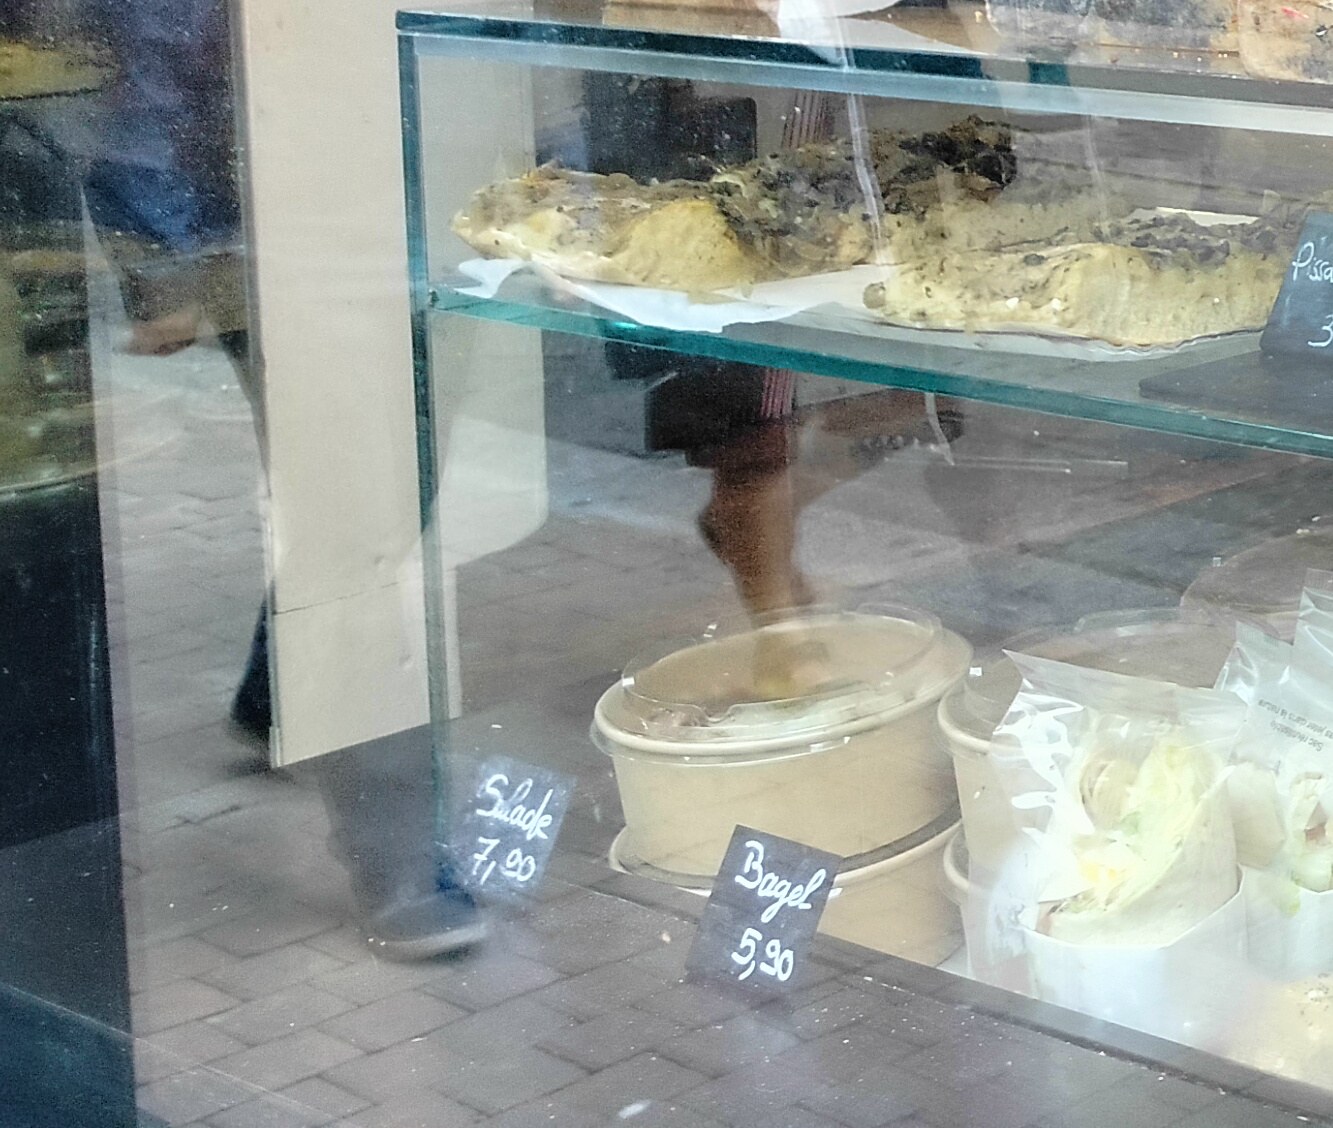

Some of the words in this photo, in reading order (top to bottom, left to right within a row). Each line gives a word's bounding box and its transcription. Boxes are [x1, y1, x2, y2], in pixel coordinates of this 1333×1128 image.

[472, 836, 537, 886] 7,90
[734, 839, 827, 923] Bagel
[731, 927, 794, 981] 5,90
